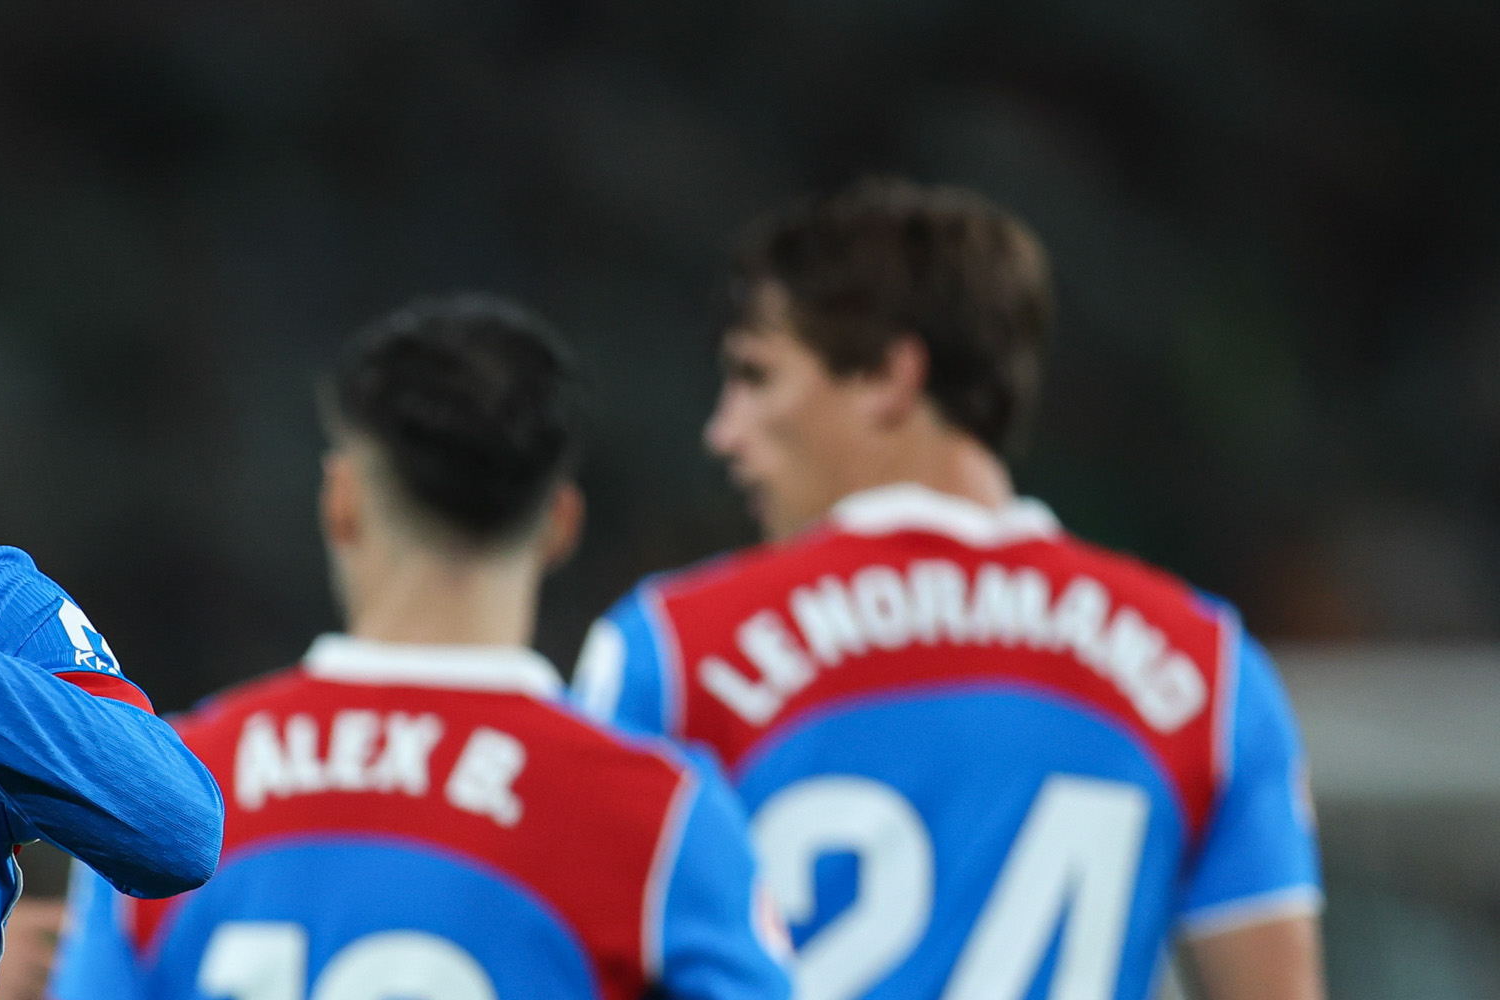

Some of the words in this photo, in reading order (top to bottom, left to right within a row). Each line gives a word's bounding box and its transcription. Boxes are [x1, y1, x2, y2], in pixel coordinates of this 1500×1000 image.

[698, 608, 817, 726] LE
[790, 558, 1208, 734] NORMAND
[235, 709, 443, 811] ALEX
